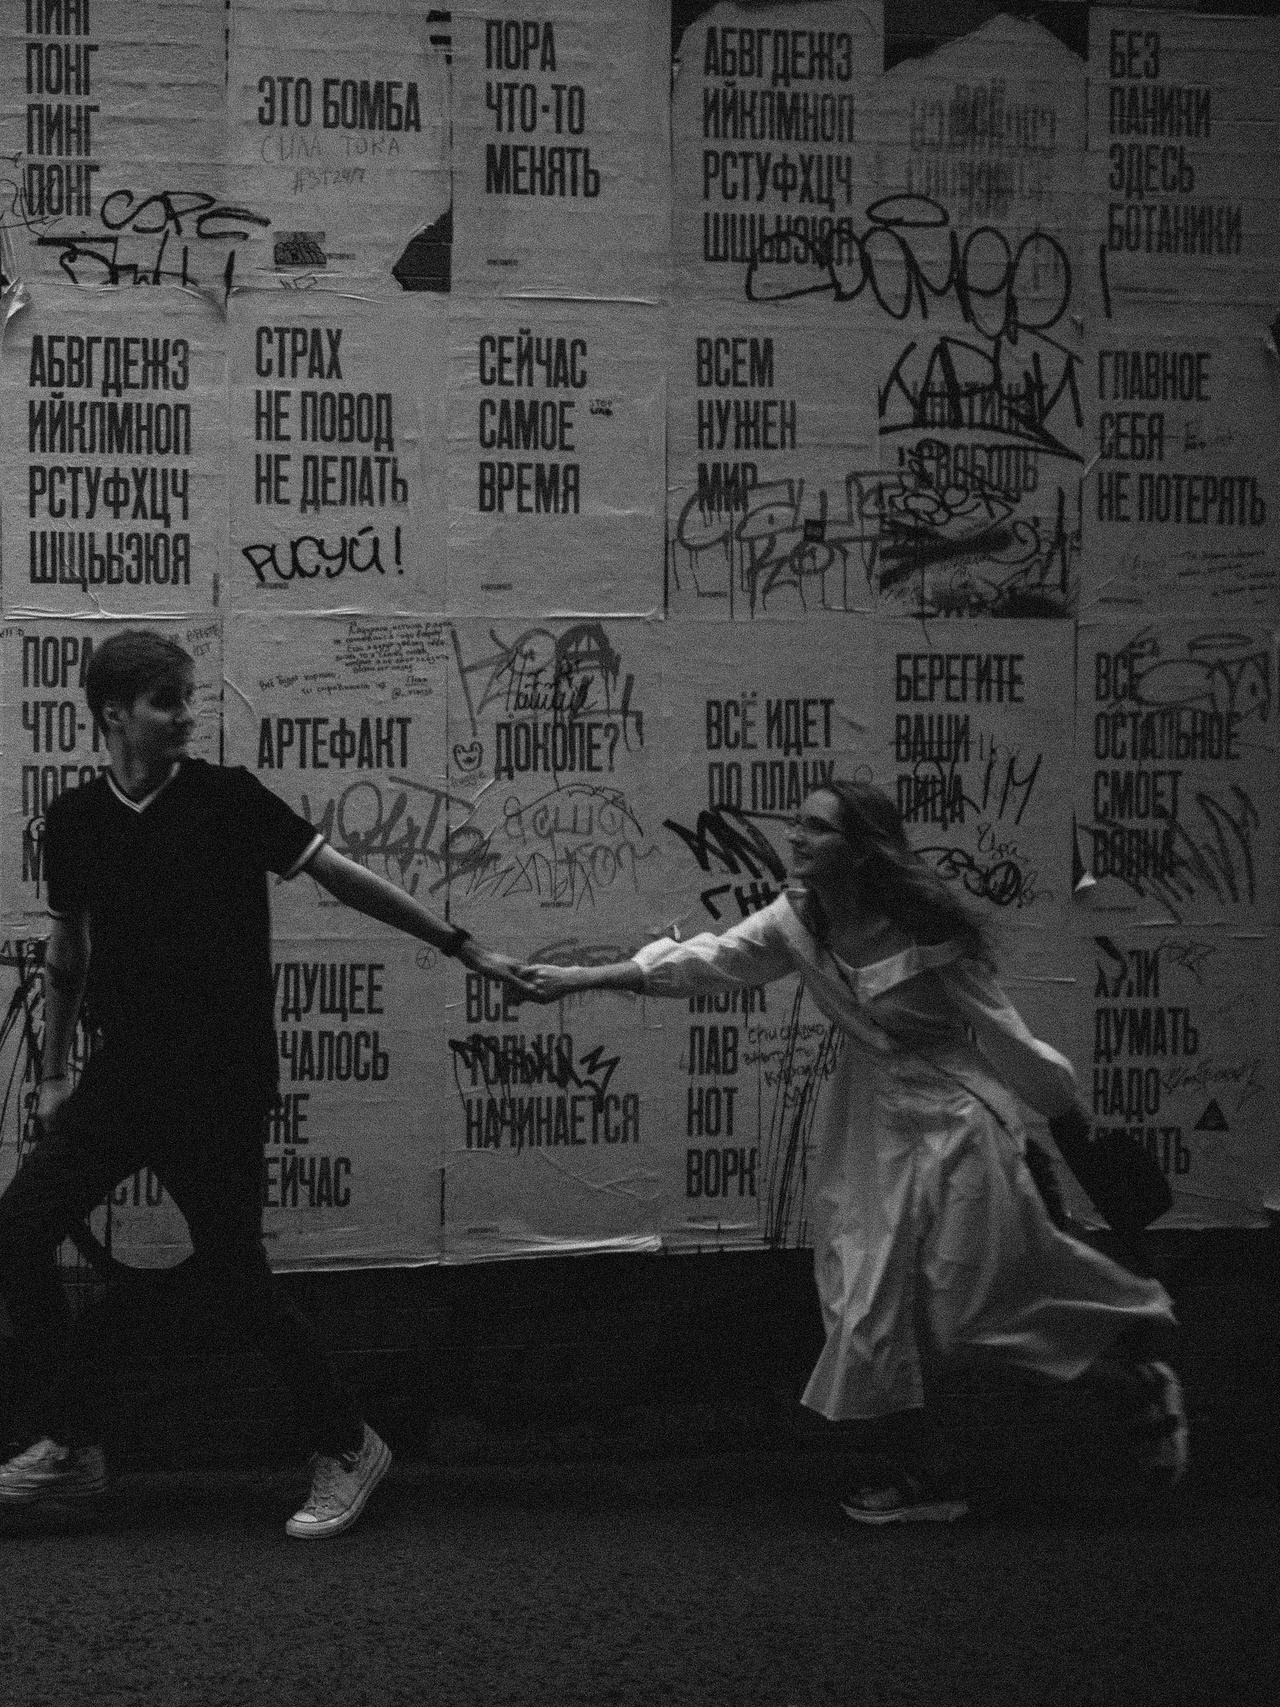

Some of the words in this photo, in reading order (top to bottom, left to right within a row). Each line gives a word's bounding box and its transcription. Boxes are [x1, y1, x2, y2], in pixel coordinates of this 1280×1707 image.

[25, 43, 98, 95] ПОНГ
[486, 20, 557, 72] ПОРА
[703, 27, 853, 86] АБВГДЕЖЗ
[1110, 29, 1159, 79] БЕЗ
[27, 104, 100, 156] ПИНГ
[257, 76, 312, 128] ЭТО
[323, 79, 421, 131] БОМБА
[486, 82, 585, 135] ЧТО-ТО
[703, 82, 853, 143] ИЙКЛМНОП
[1110, 85, 1211, 138] ПАНИКИ
[27, 164, 100, 217] ПОНГ
[486, 144, 601, 197] МЕНЯТЬ
[703, 150, 852, 211] РСТУФХЦЧ
[1110, 143, 1195, 199] ЗДЕСЬ
[1109, 202, 1242, 255] БОТАНИКИ
[29, 336, 190, 397] АБВГДЕЖЗ
[256, 326, 343, 380] СТРАХ
[479, 329, 587, 388] СЕЙЧАС
[696, 337, 773, 388] ВСЕМ
[1099, 351, 1211, 401] ГЛАВНОЕ
[28, 393, 191, 454] ИЙКЛМНОП
[256, 390, 291, 441] НЕ
[301, 392, 394, 452] ПОВОД
[479, 400, 576, 451] САМОЕ
[697, 400, 796, 450] НУЖЕН
[1100, 412, 1164, 461] СЕБЯ
[29, 465, 190, 528] РСТУФХЦЧ
[256, 454, 291, 505] НЕ
[300, 456, 409, 514] ДЕЛАТЬ
[479, 462, 580, 514] ВРЕМЯ
[697, 463, 757, 513] МИР
[1098, 472, 1130, 522] НЕ
[1139, 473, 1266, 526] ПОТЕРЯТЬ
[896, 654, 1024, 702] БЕРЕГИТЕ
[259, 717, 411, 768] АРТЕФАКТ
[707, 692, 756, 749] ВСЁ
[766, 699, 834, 756] ИДЕТ
[896, 715, 970, 761] ВАШИ
[1095, 711, 1241, 760] ОСТАЛЬНОЕ
[496, 722, 619, 780] ДОКОЛЕ?
[708, 761, 741, 810] ПО
[1094, 771, 1181, 820] СМОЕТ
[1094, 1008, 1198, 1063] ДУМАТЬ
[466, 1094, 639, 1149] НАЧИНАЕТСЯ
[687, 1087, 738, 1136] НОТ
[1093, 1068, 1161, 1123] НАДО
[263, 1149, 352, 1208] ЕЙЧАС
[686, 1148, 756, 1197] ВОРК
